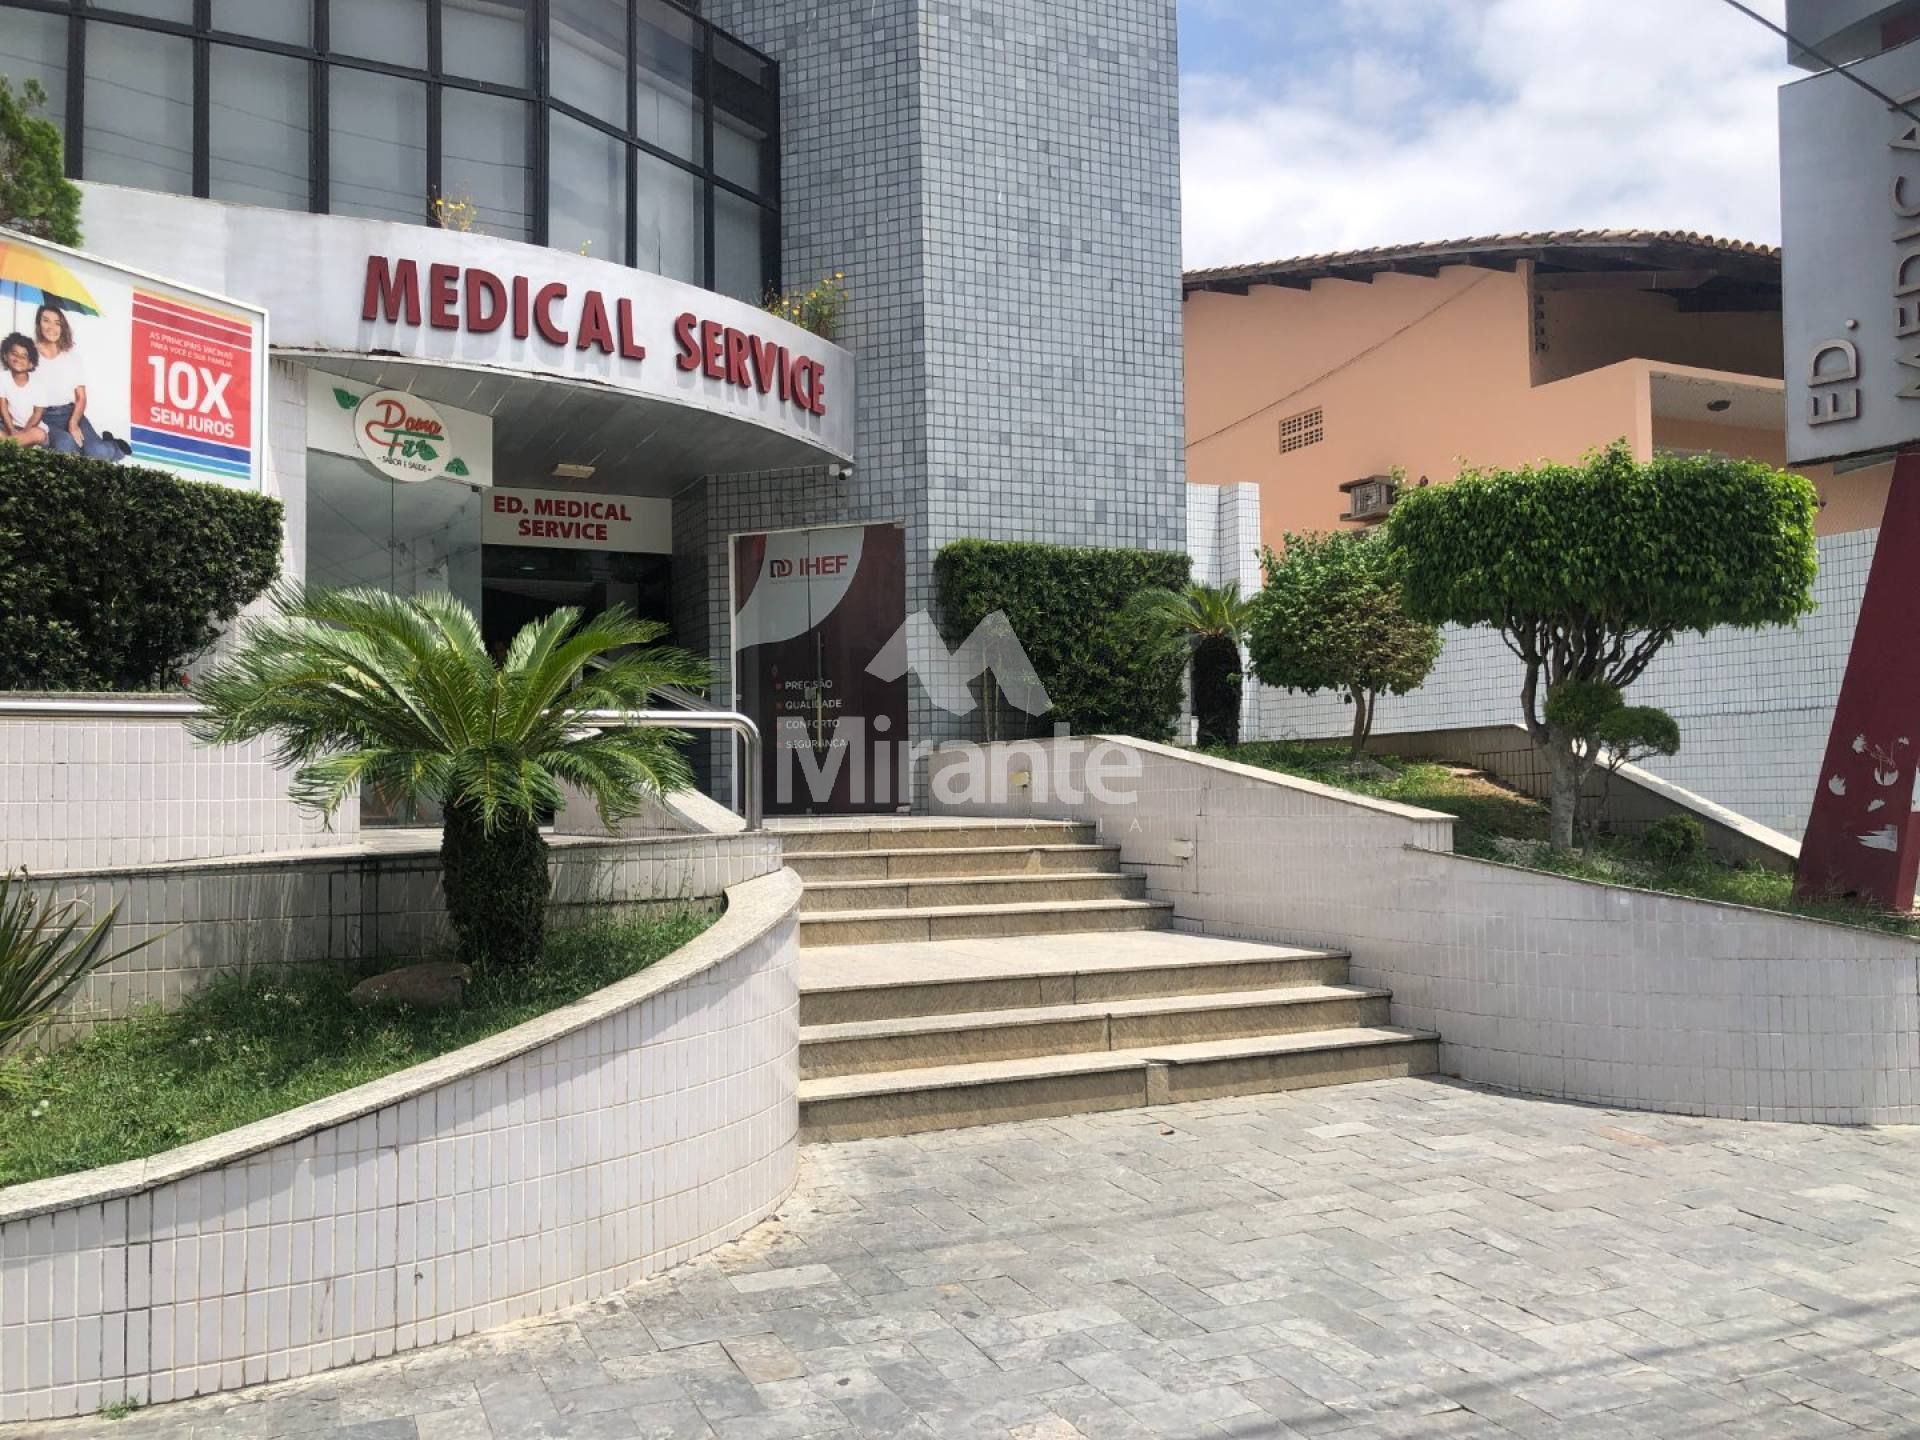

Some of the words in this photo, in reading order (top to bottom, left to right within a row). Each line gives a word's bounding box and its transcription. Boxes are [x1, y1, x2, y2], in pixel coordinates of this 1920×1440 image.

[362, 255, 645, 360] MEDICAL
[675, 312, 826, 416] SERVICE
[147, 355, 233, 420] 10X
[1807, 318, 1860, 426] ED.
[150, 406, 184, 429] SEM
[186, 414, 235, 439] JUROS
[493, 495, 529, 515] ED.
[534, 498, 632, 521] MEDICAL
[518, 519, 608, 541] SERVICE
[799, 555, 849, 577] IHEF
